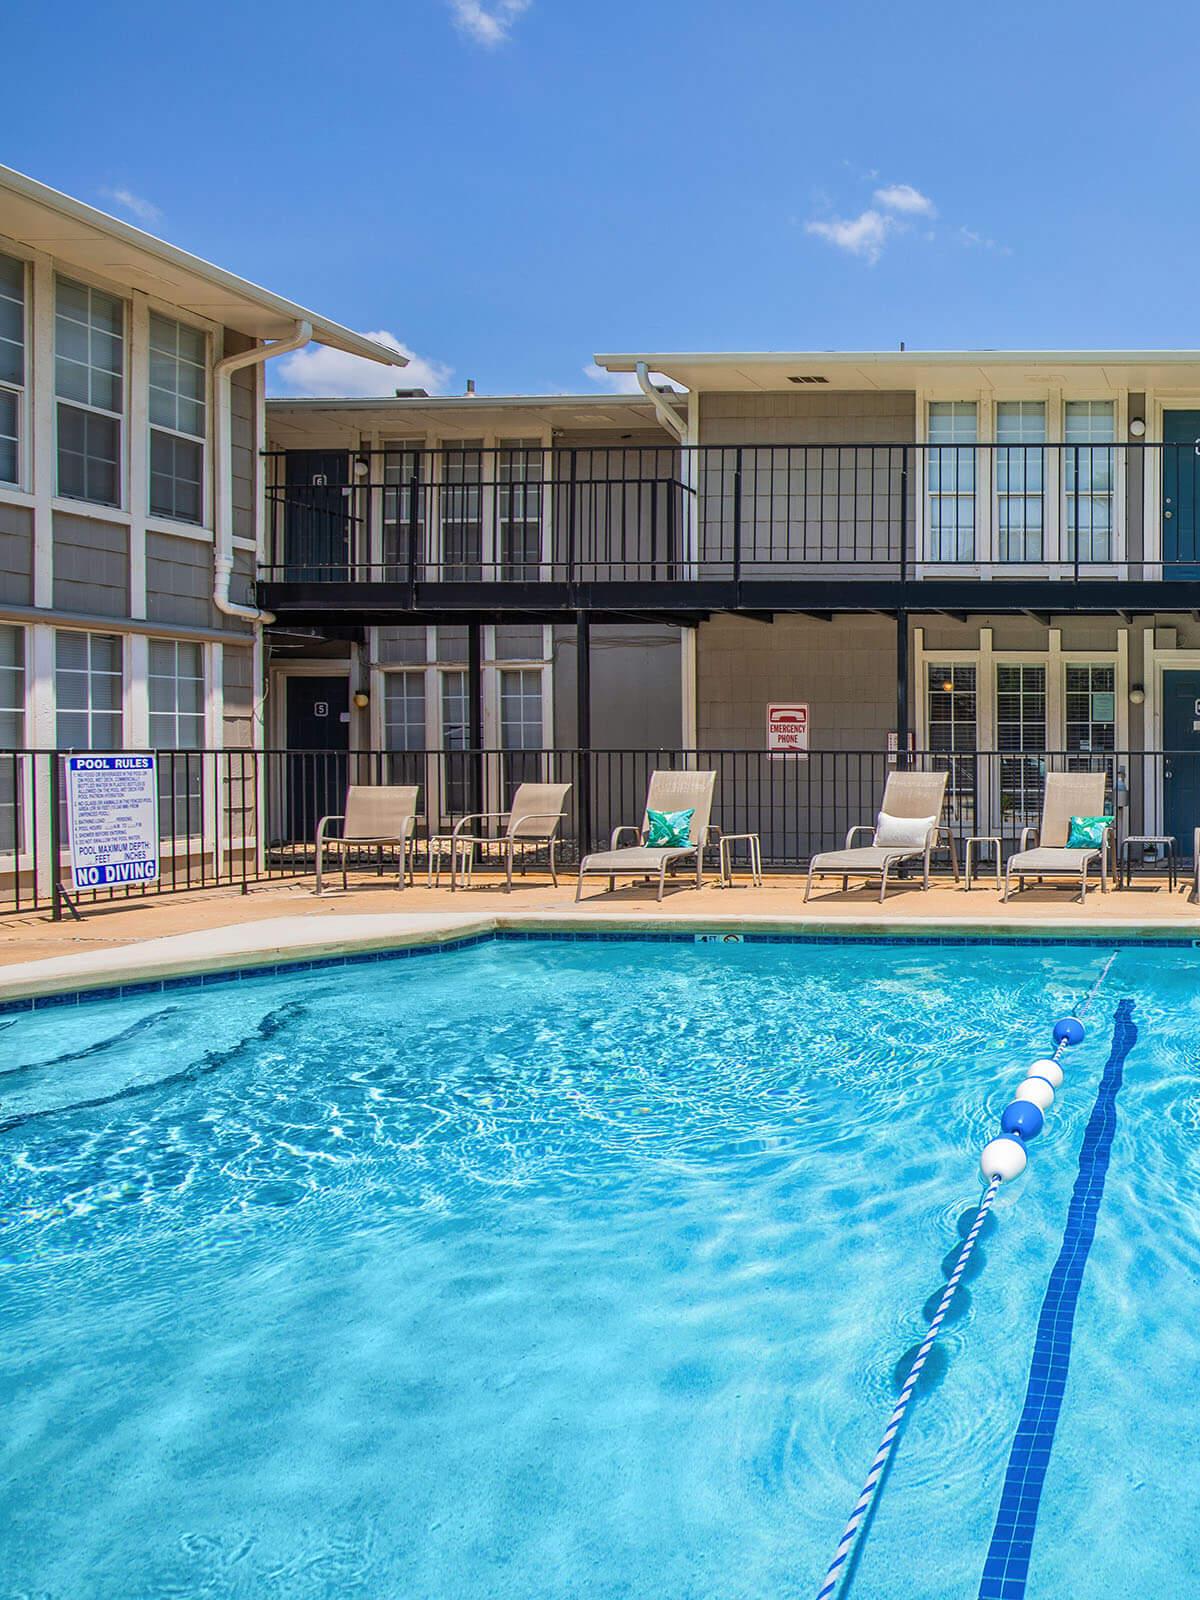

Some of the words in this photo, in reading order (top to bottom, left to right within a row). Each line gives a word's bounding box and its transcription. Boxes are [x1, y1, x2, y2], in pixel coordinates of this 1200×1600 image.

[318, 705, 324, 714] 5
[770, 724, 806, 734] EMERGENCY
[778, 734, 798, 744] PHONE
[76, 760, 110, 769] POOL
[114, 758, 149, 768] RULES
[80, 846, 96, 855] POOL
[98, 844, 128, 852] MAXIMUM
[95, 854, 110, 864] FEET
[124, 850, 146, 860] INCHES
[78, 867, 99, 885] NO
[105, 861, 154, 882] DIVING
